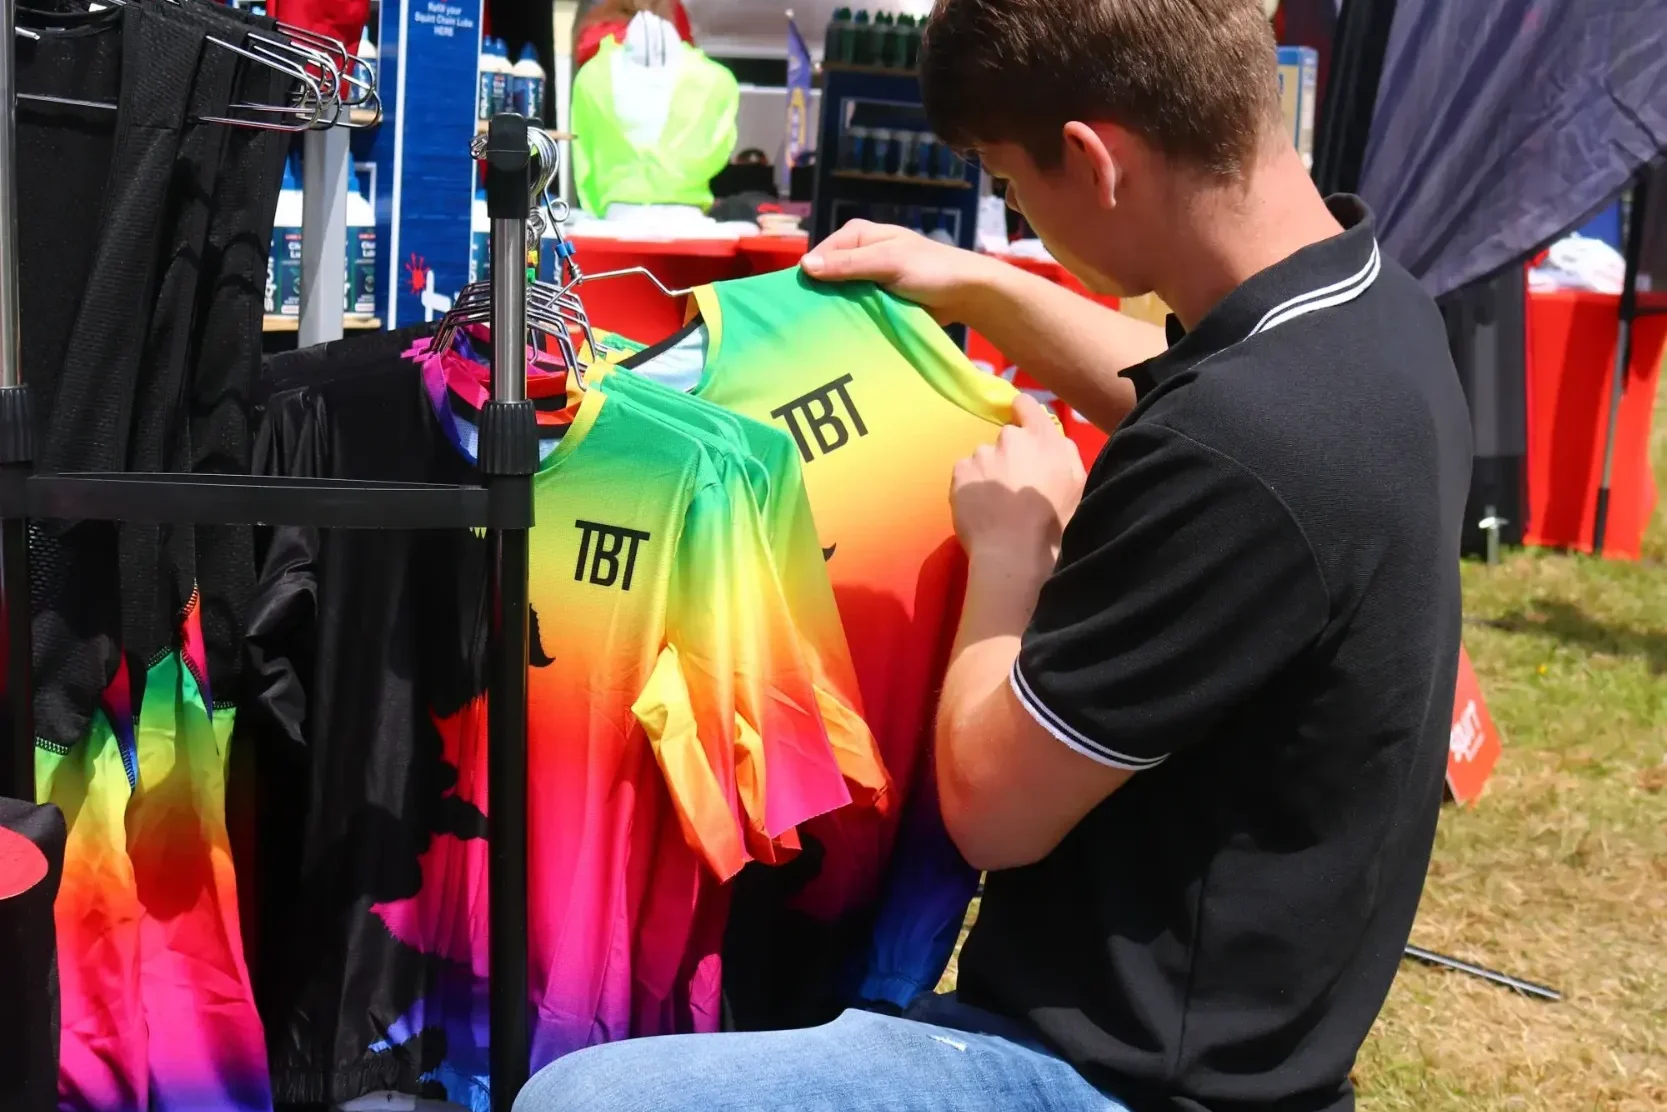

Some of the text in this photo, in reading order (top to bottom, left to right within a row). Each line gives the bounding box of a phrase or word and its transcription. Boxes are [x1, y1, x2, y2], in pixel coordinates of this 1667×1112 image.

[434, 26, 454, 37] HERE
[770, 372, 869, 464] TBT
[574, 519, 650, 591] TBT
